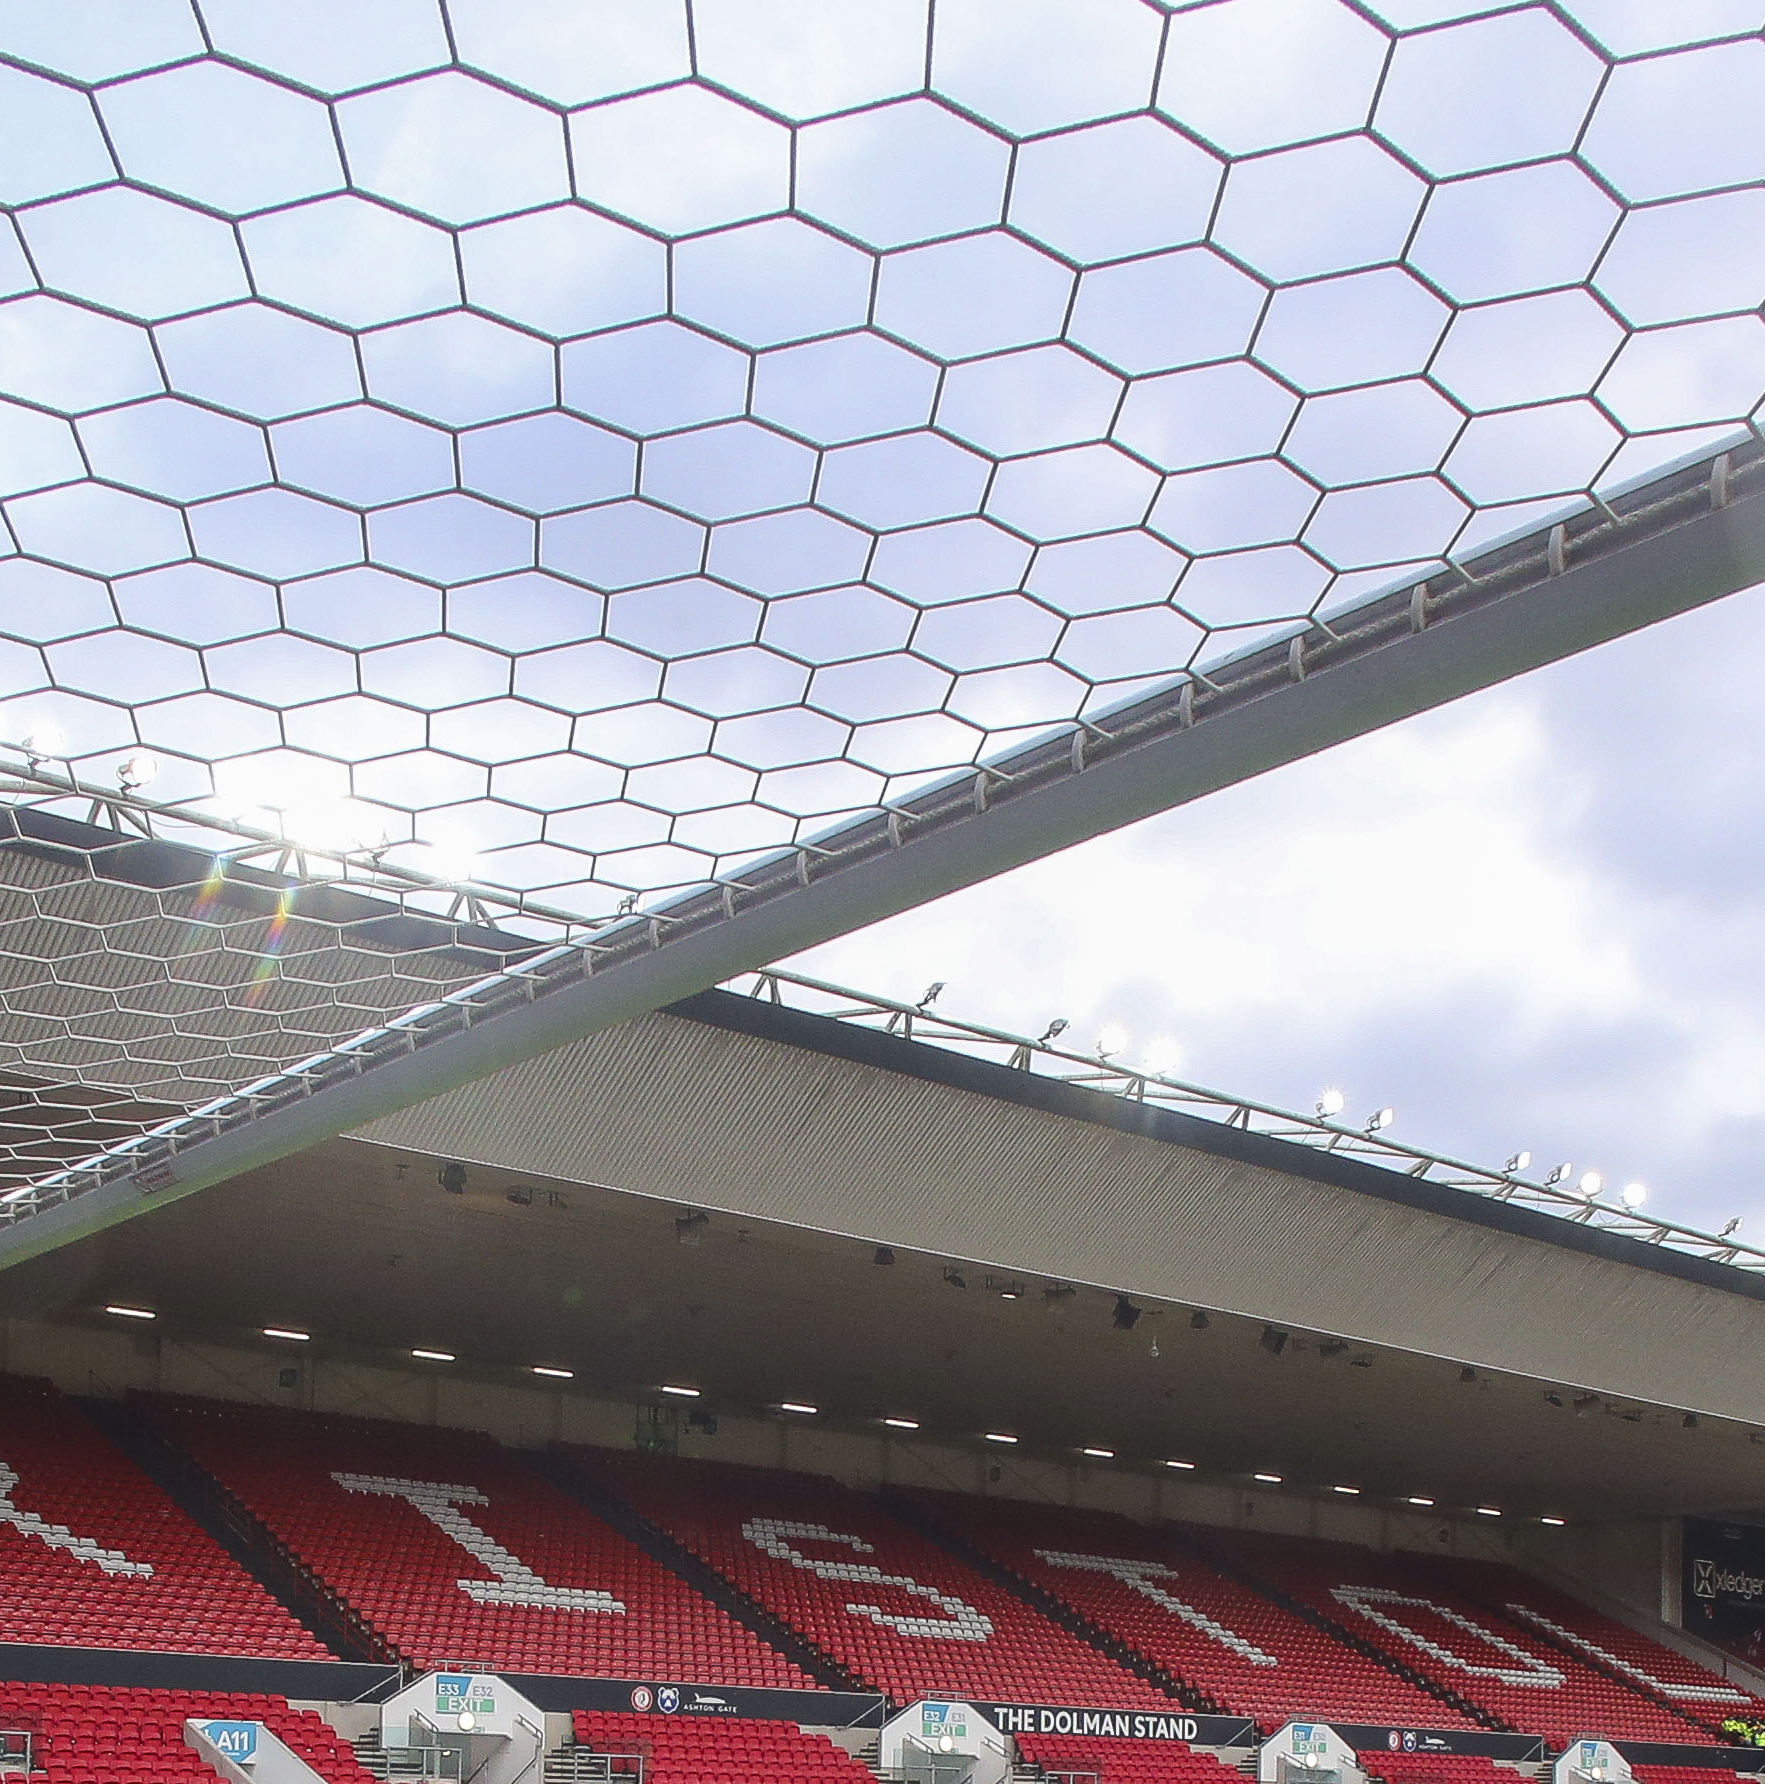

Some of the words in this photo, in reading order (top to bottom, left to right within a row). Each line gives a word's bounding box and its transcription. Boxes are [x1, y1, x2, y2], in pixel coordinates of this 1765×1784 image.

[1715, 1568, 1765, 1600] xledger
[438, 1683, 459, 1695] E33
[474, 1686, 493, 1696] E32
[448, 1697, 484, 1712] EXIT
[683, 1704, 715, 1712] ASHTON
[718, 1705, 738, 1713] GATE
[924, 1711, 940, 1721] E32
[931, 1724, 958, 1735] EXIT
[994, 1707, 1034, 1732] THE
[1040, 1710, 1129, 1737] DOLMAN
[1134, 1716, 1198, 1740] STAND
[217, 1731, 249, 1751] A11
[1299, 1743, 1320, 1751] EXIT
